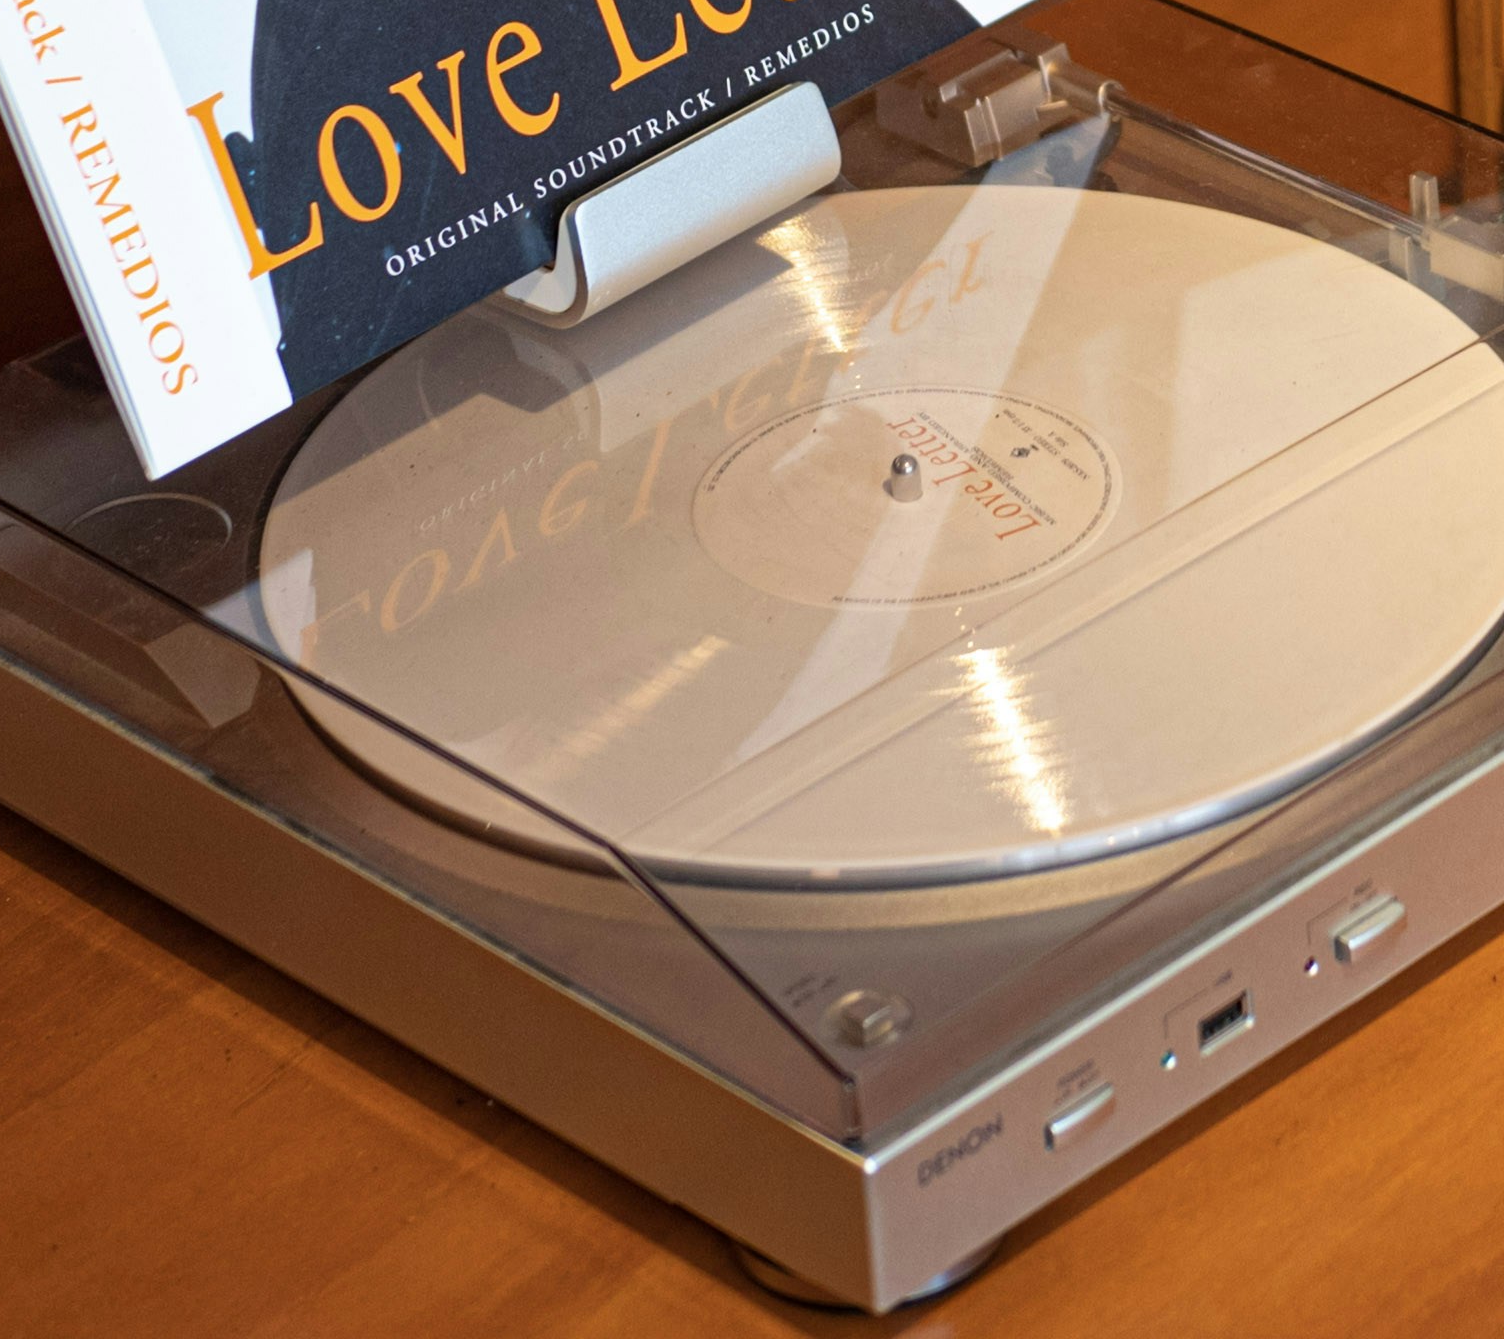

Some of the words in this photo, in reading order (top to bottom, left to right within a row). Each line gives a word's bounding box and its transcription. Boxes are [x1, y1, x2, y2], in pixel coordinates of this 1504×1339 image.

[186, 15, 561, 280] Love
[384, 191, 527, 280] ORIGINAL
[533, 85, 718, 202] SOUNDTRACK
[742, 1, 879, 89] REMEDIOS
[59, 101, 199, 398] REMEDIOS
[886, 417, 978, 486] Letter
[965, 479, 1042, 540] Love
[916, 1114, 1003, 1188] DENON
